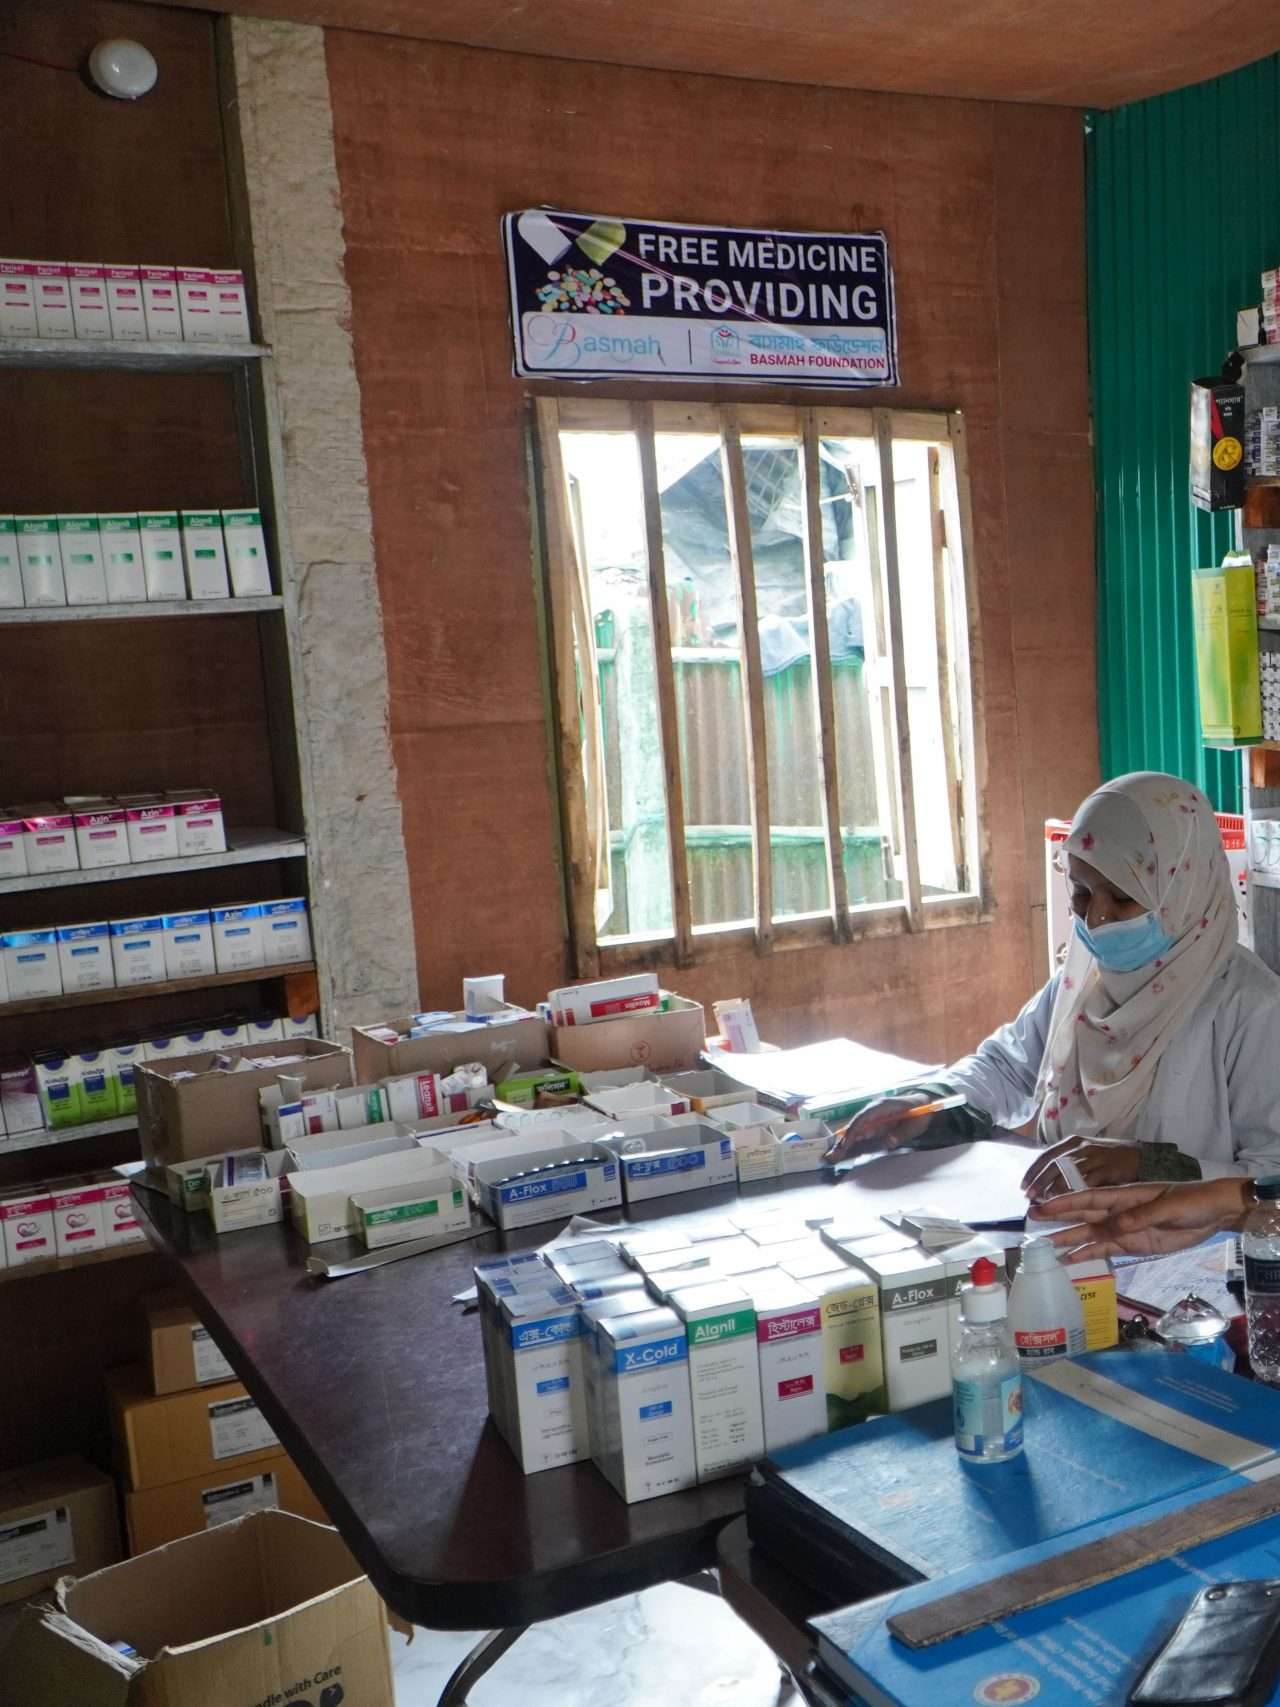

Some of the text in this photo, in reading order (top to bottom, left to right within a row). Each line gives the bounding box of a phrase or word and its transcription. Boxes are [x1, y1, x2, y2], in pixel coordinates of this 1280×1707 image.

[638, 233, 877, 273] FREE MEDICINE
[641, 273, 878, 320] PROVIDING
[527, 315, 666, 368] Basmah
[751, 353, 806, 366] BASMAH
[808, 355, 885, 369] FOUNDATION
[510, 1183, 547, 1200] A-Flox
[892, 1287, 934, 1307] A-Flox
[695, 1319, 736, 1339] Alanil
[625, 1343, 678, 1367] X-Cold
[284, 1678, 311, 1698] with
[314, 1665, 341, 1684] Care
